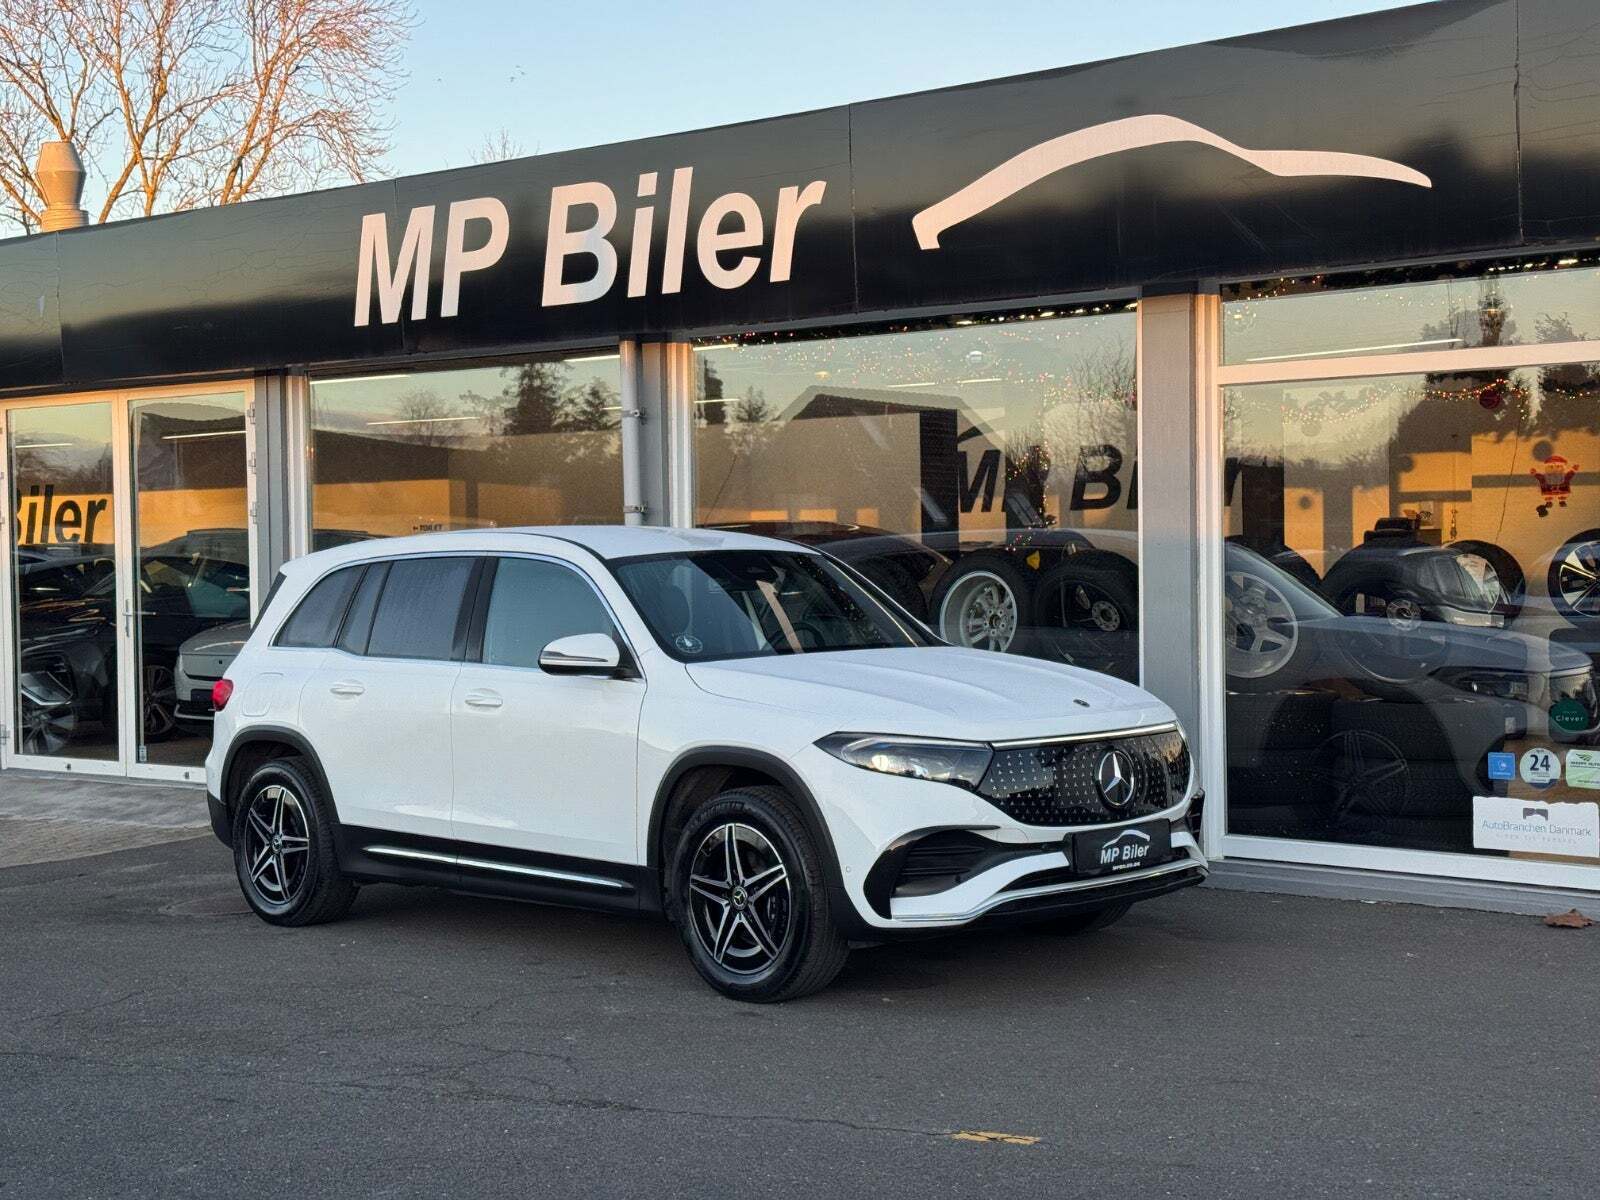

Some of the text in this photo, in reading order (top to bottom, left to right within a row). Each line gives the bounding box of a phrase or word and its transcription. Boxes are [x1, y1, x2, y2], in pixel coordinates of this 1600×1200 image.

[354, 166, 827, 327] MP Biler
[1529, 754, 1551, 771] 24
[1482, 820, 1592, 836] AutoBranchen Danmark
[1100, 843, 1150, 864] MP Biler
